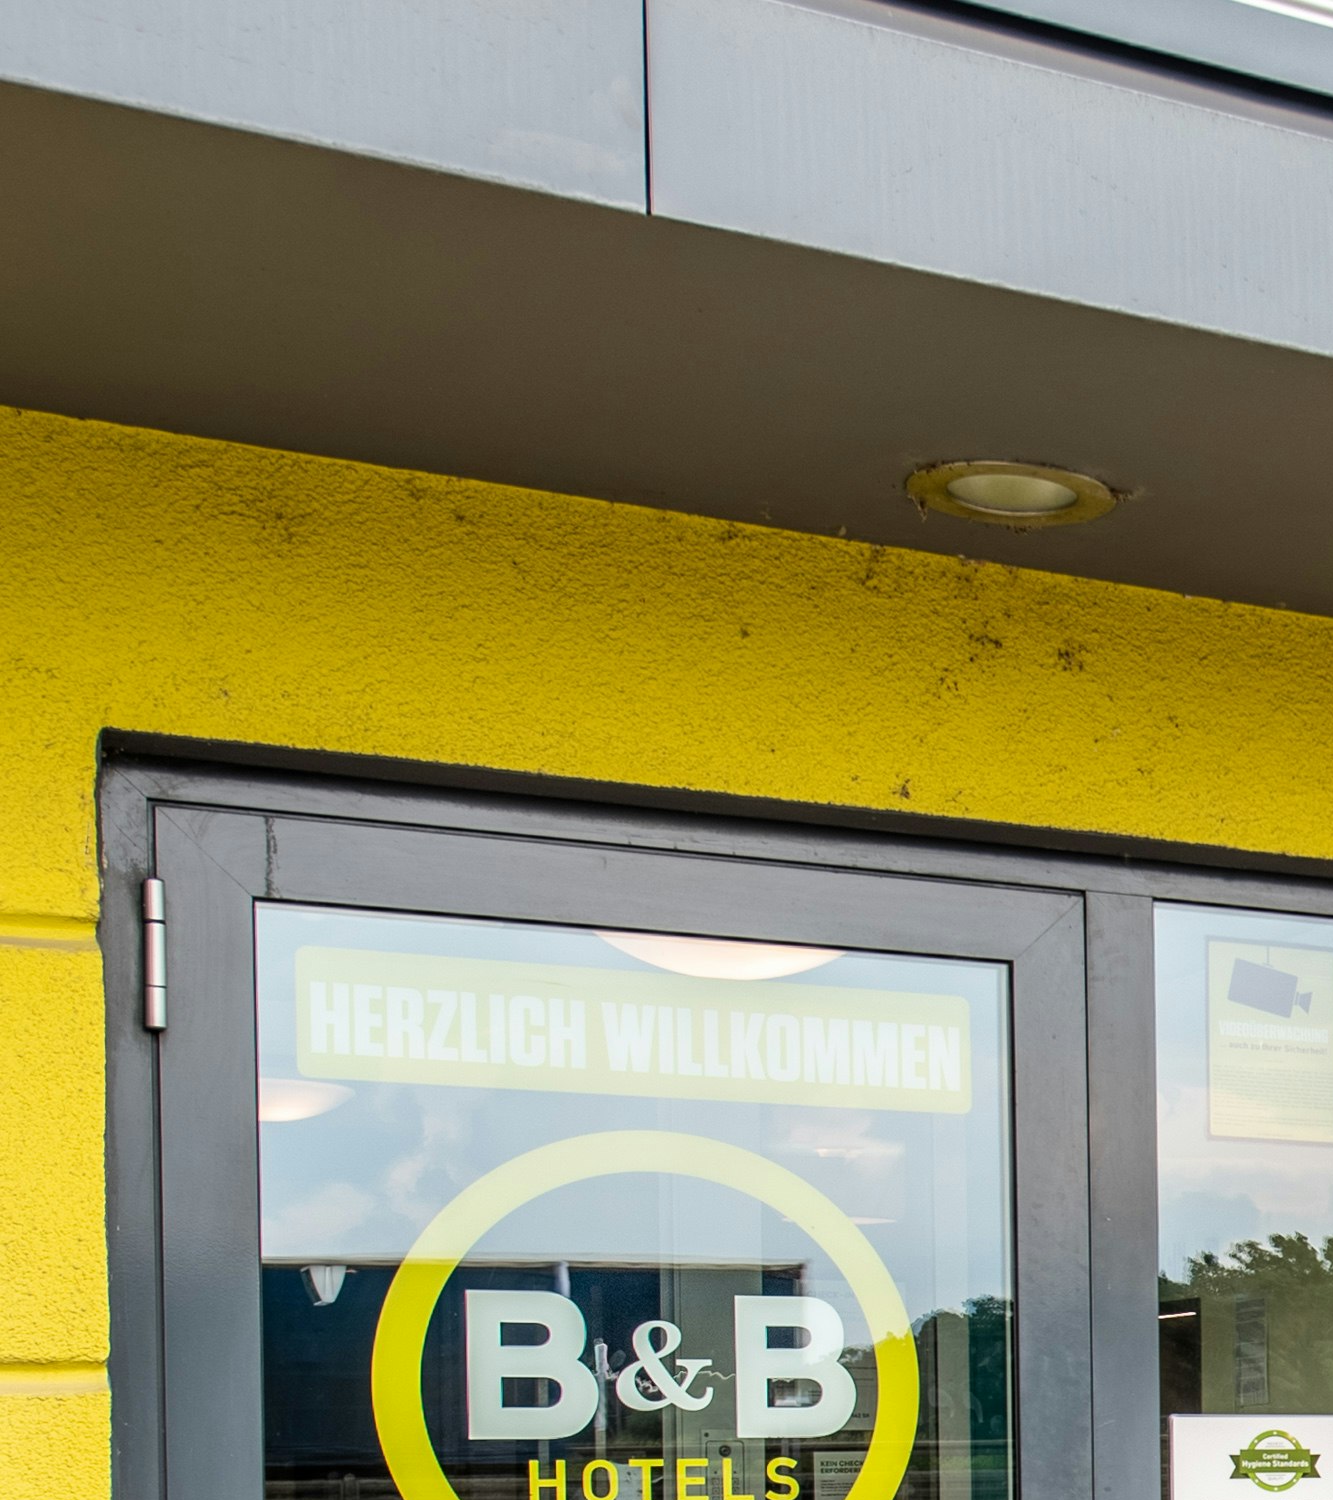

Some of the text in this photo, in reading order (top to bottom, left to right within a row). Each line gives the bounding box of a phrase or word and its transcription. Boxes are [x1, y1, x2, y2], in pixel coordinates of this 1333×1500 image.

[308, 980, 962, 1093] HERZLICH WILLKOMMEN
[464, 1288, 858, 1441] B&B
[1241, 1460, 1309, 1469] Hygiene Standards
